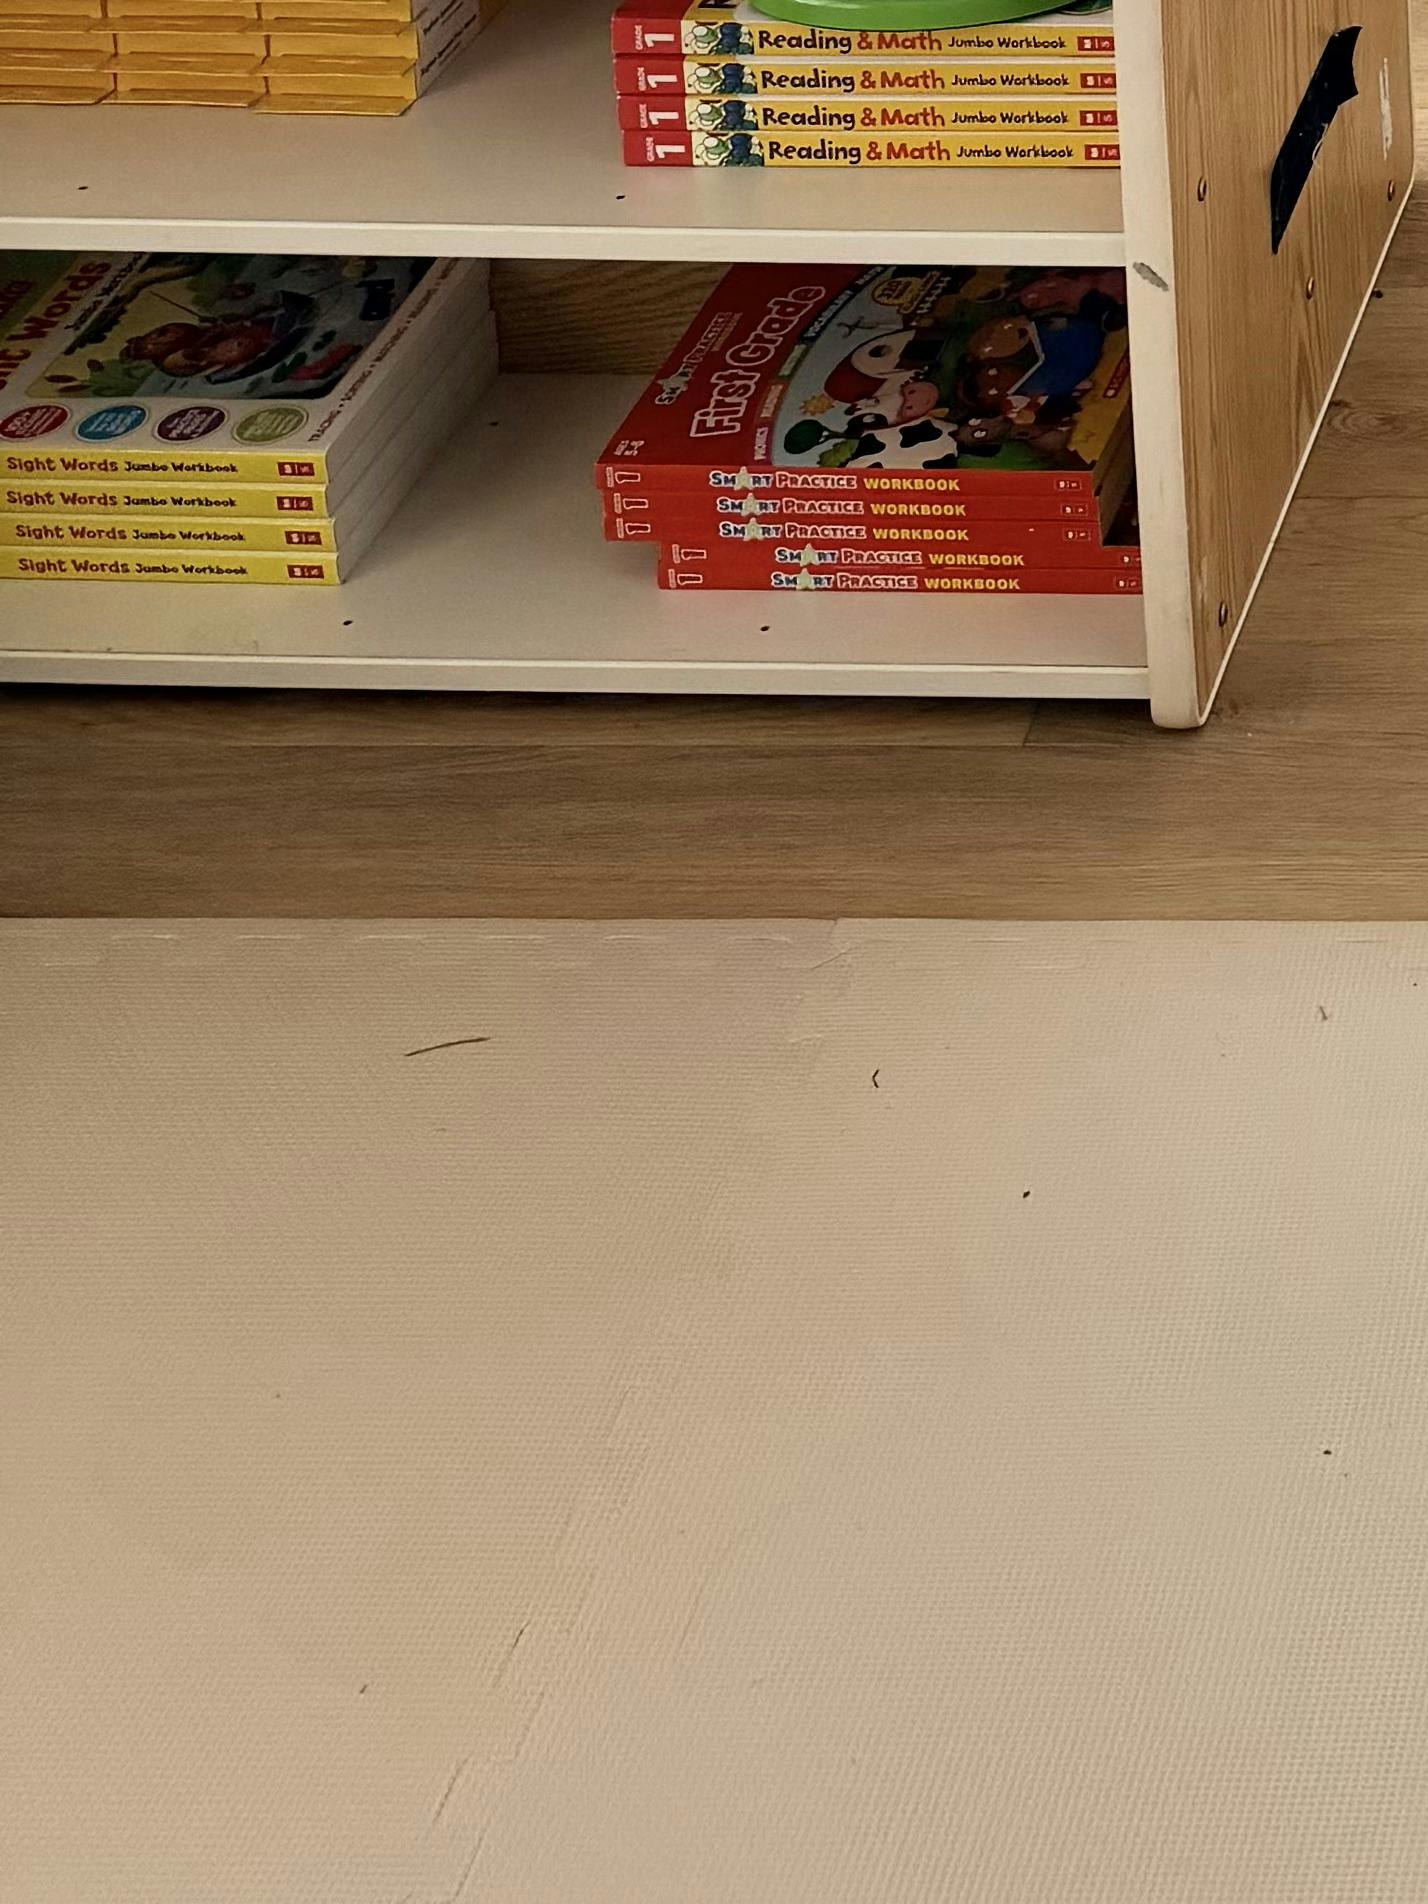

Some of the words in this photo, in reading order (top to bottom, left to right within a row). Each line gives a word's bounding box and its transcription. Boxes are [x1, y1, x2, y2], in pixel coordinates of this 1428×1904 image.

[644, 33, 675, 48] 1
[758, 28, 852, 54] Reading
[857, 31, 873, 51] &
[877, 31, 943, 52] Math
[947, 35, 994, 49] Jumbo
[996, 36, 1067, 50] Workbook
[646, 74, 678, 89] 1
[761, 67, 855, 93] Reading
[859, 70, 877, 89] &
[880, 68, 945, 89] Math
[951, 74, 997, 87] Jumbo
[1000, 74, 1070, 87] Workbook
[648, 111, 680, 126] 1
[762, 104, 856, 131] Reading
[860, 107, 877, 126] &
[880, 106, 945, 127] Math
[951, 111, 997, 124] Jumbo
[1000, 111, 1069, 125] Workbook
[654, 144, 686, 159] 1
[768, 138, 861, 165] Reading
[865, 141, 883, 160] &
[886, 140, 951, 161] Math
[956, 145, 1002, 159] Jumbo
[1004, 145, 1074, 159] Workbook
[689, 368, 761, 438] First
[725, 286, 826, 367] Grade
[6, 456, 56, 473] Sight
[59, 458, 119, 472] Words
[124, 461, 169, 473] Jumbo
[171, 462, 238, 474] Workbook
[776, 470, 858, 489] PRACTICE
[863, 478, 960, 491] WORKBOOK
[6, 491, 55, 507] Sight
[59, 492, 118, 507] Words
[123, 495, 168, 507] Jumbo
[170, 496, 237, 508] Workbook
[782, 496, 865, 515] PRACTICE
[870, 503, 967, 517] WORKBOOK
[15, 524, 65, 541] Sight
[68, 526, 127, 540] Words
[132, 529, 176, 541] Jumbo
[179, 530, 245, 542] Workbook
[784, 521, 867, 540] PRACTICE
[873, 527, 969, 541] WORKBOOK
[18, 558, 67, 574] Sight
[71, 559, 130, 574] Words
[135, 563, 179, 575] Jumbo
[181, 564, 249, 576] Workbook
[841, 549, 923, 564] PRACTICE
[929, 553, 1025, 567] WORKBOOK
[836, 574, 919, 590] PRACTICE
[924, 577, 1021, 591] WORKBOOK
